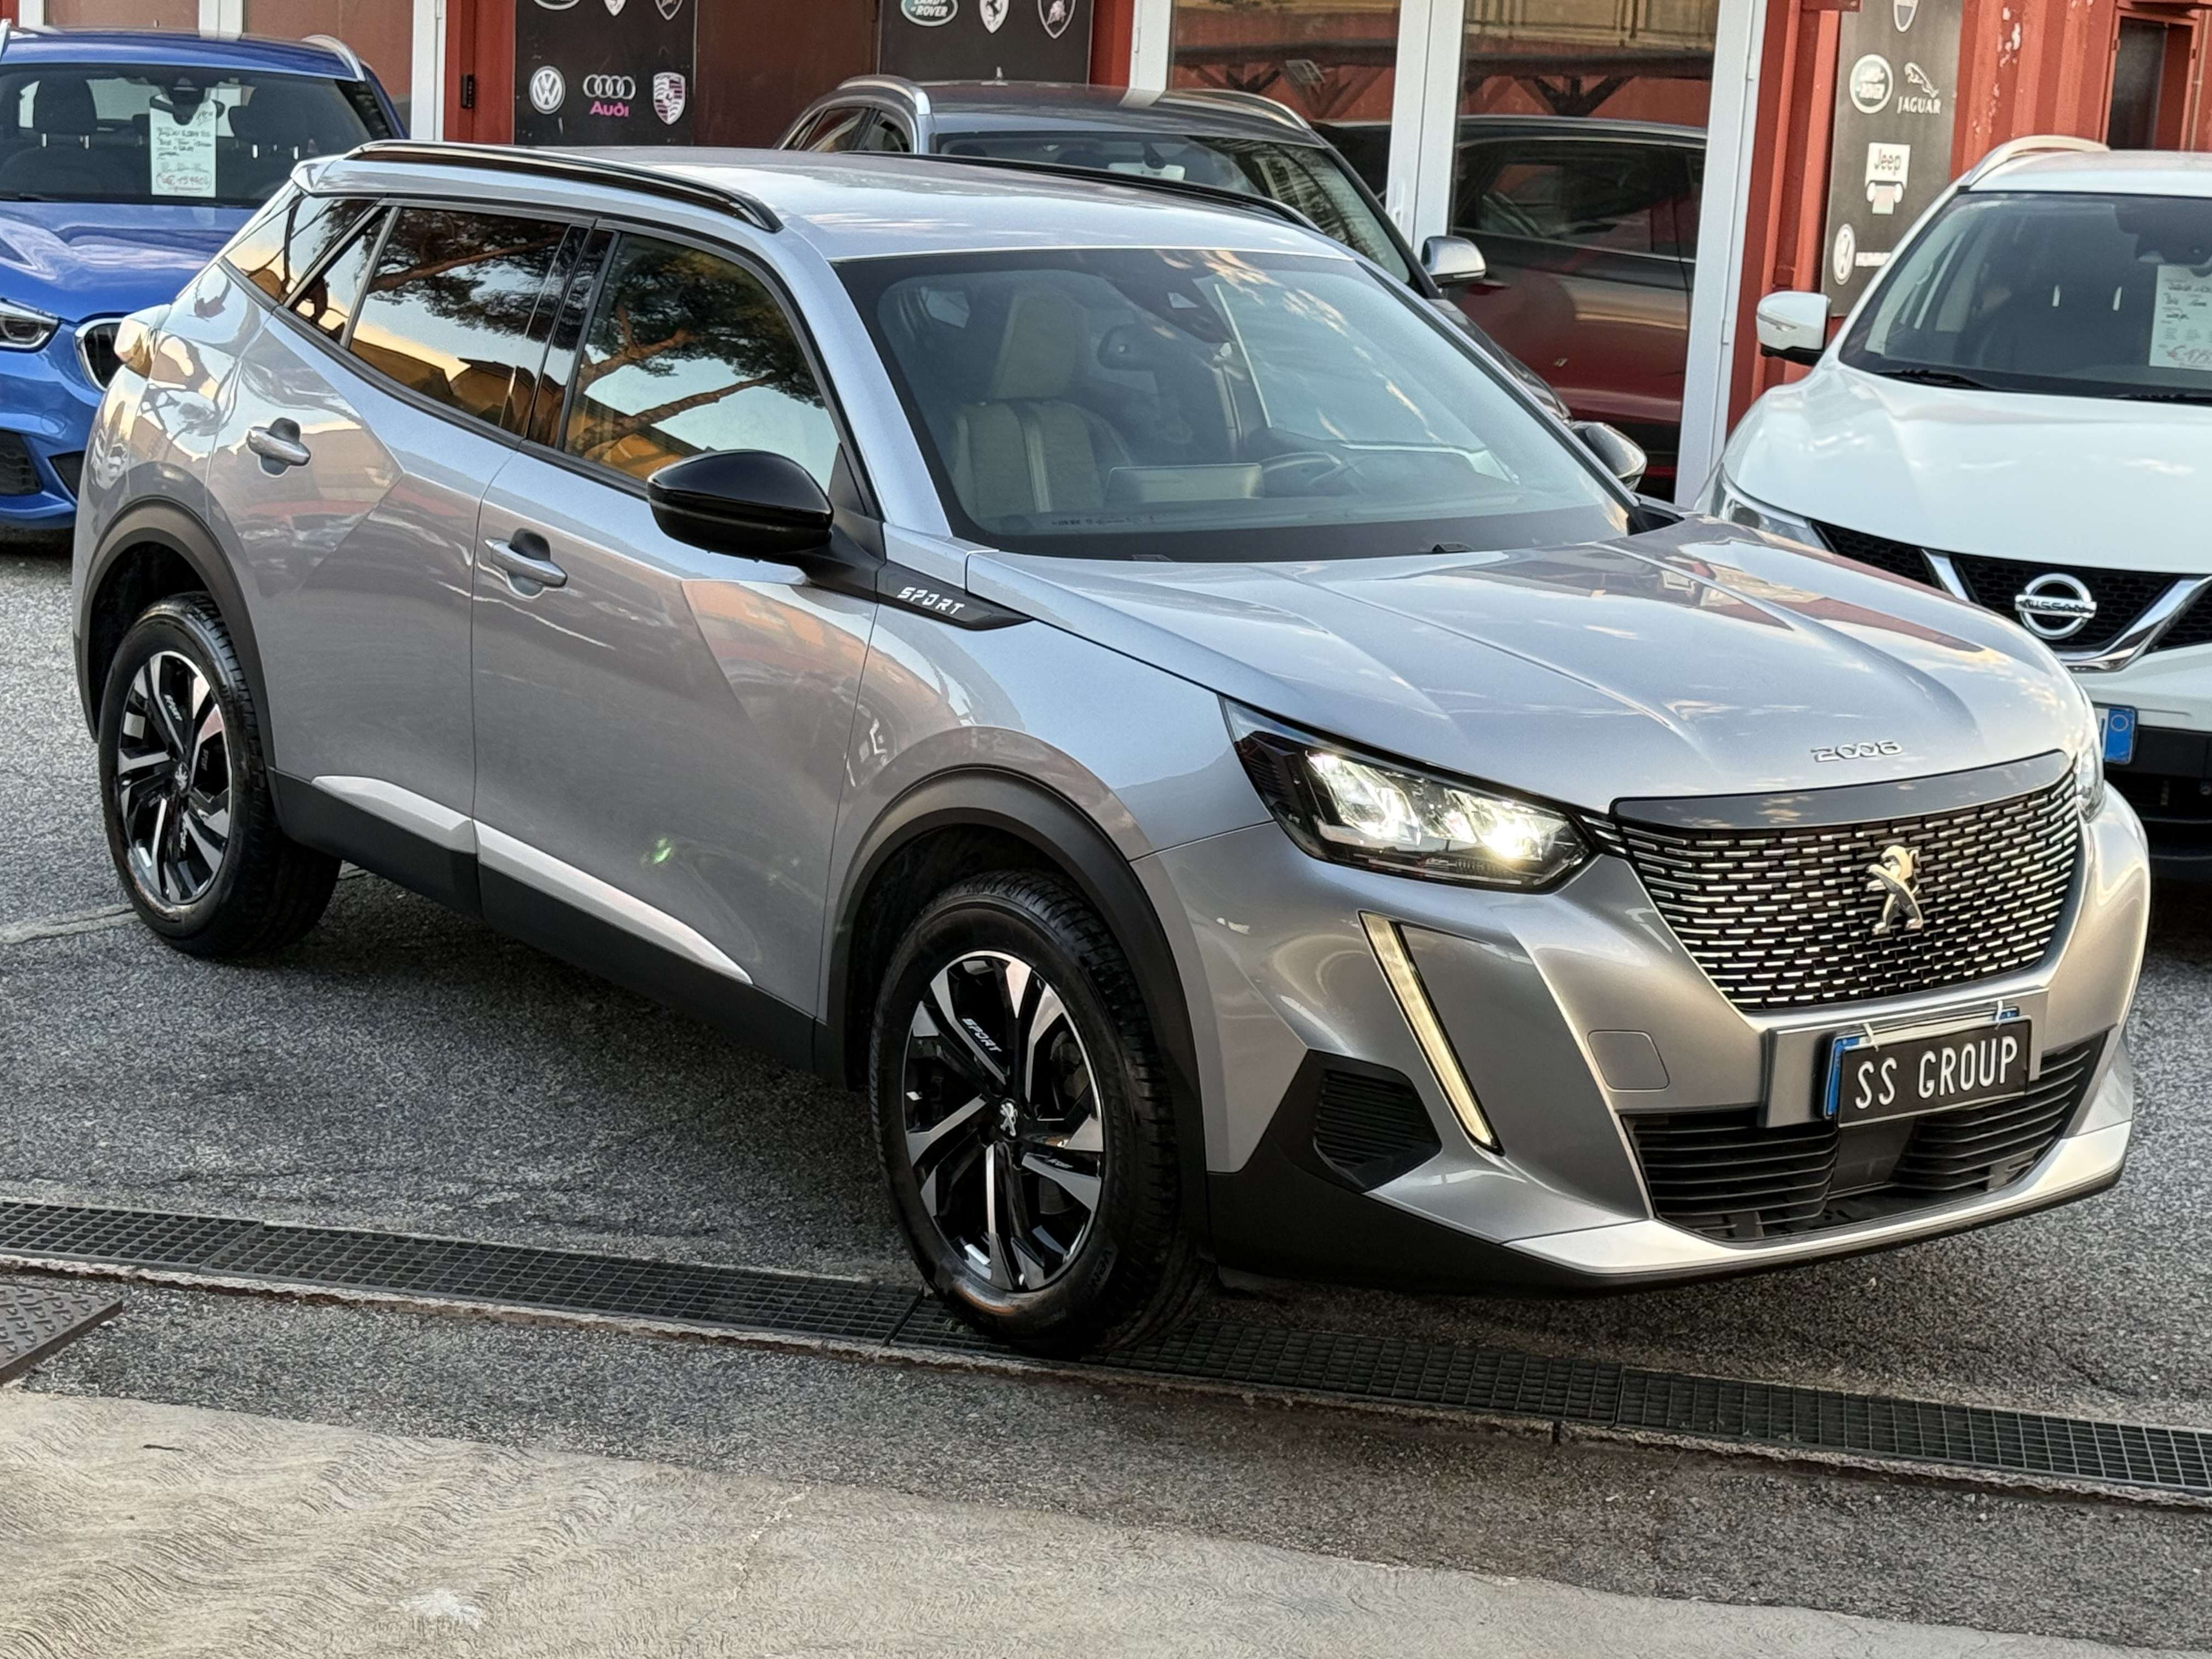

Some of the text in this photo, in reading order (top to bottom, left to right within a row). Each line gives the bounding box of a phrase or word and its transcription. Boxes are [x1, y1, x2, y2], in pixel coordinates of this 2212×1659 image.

[916, 5, 949, 17] ROVER
[589, 101, 630, 117] Audi
[1897, 96, 1942, 114] JAGUAR
[1874, 148, 1901, 176] Jeep
[896, 586, 966, 615] SPORT
[2023, 599, 2084, 613] NISSAN
[1810, 739, 1903, 763] 2008
[961, 1018, 1002, 1053] SPORT
[1855, 1035, 2018, 1110] SS GROUP
